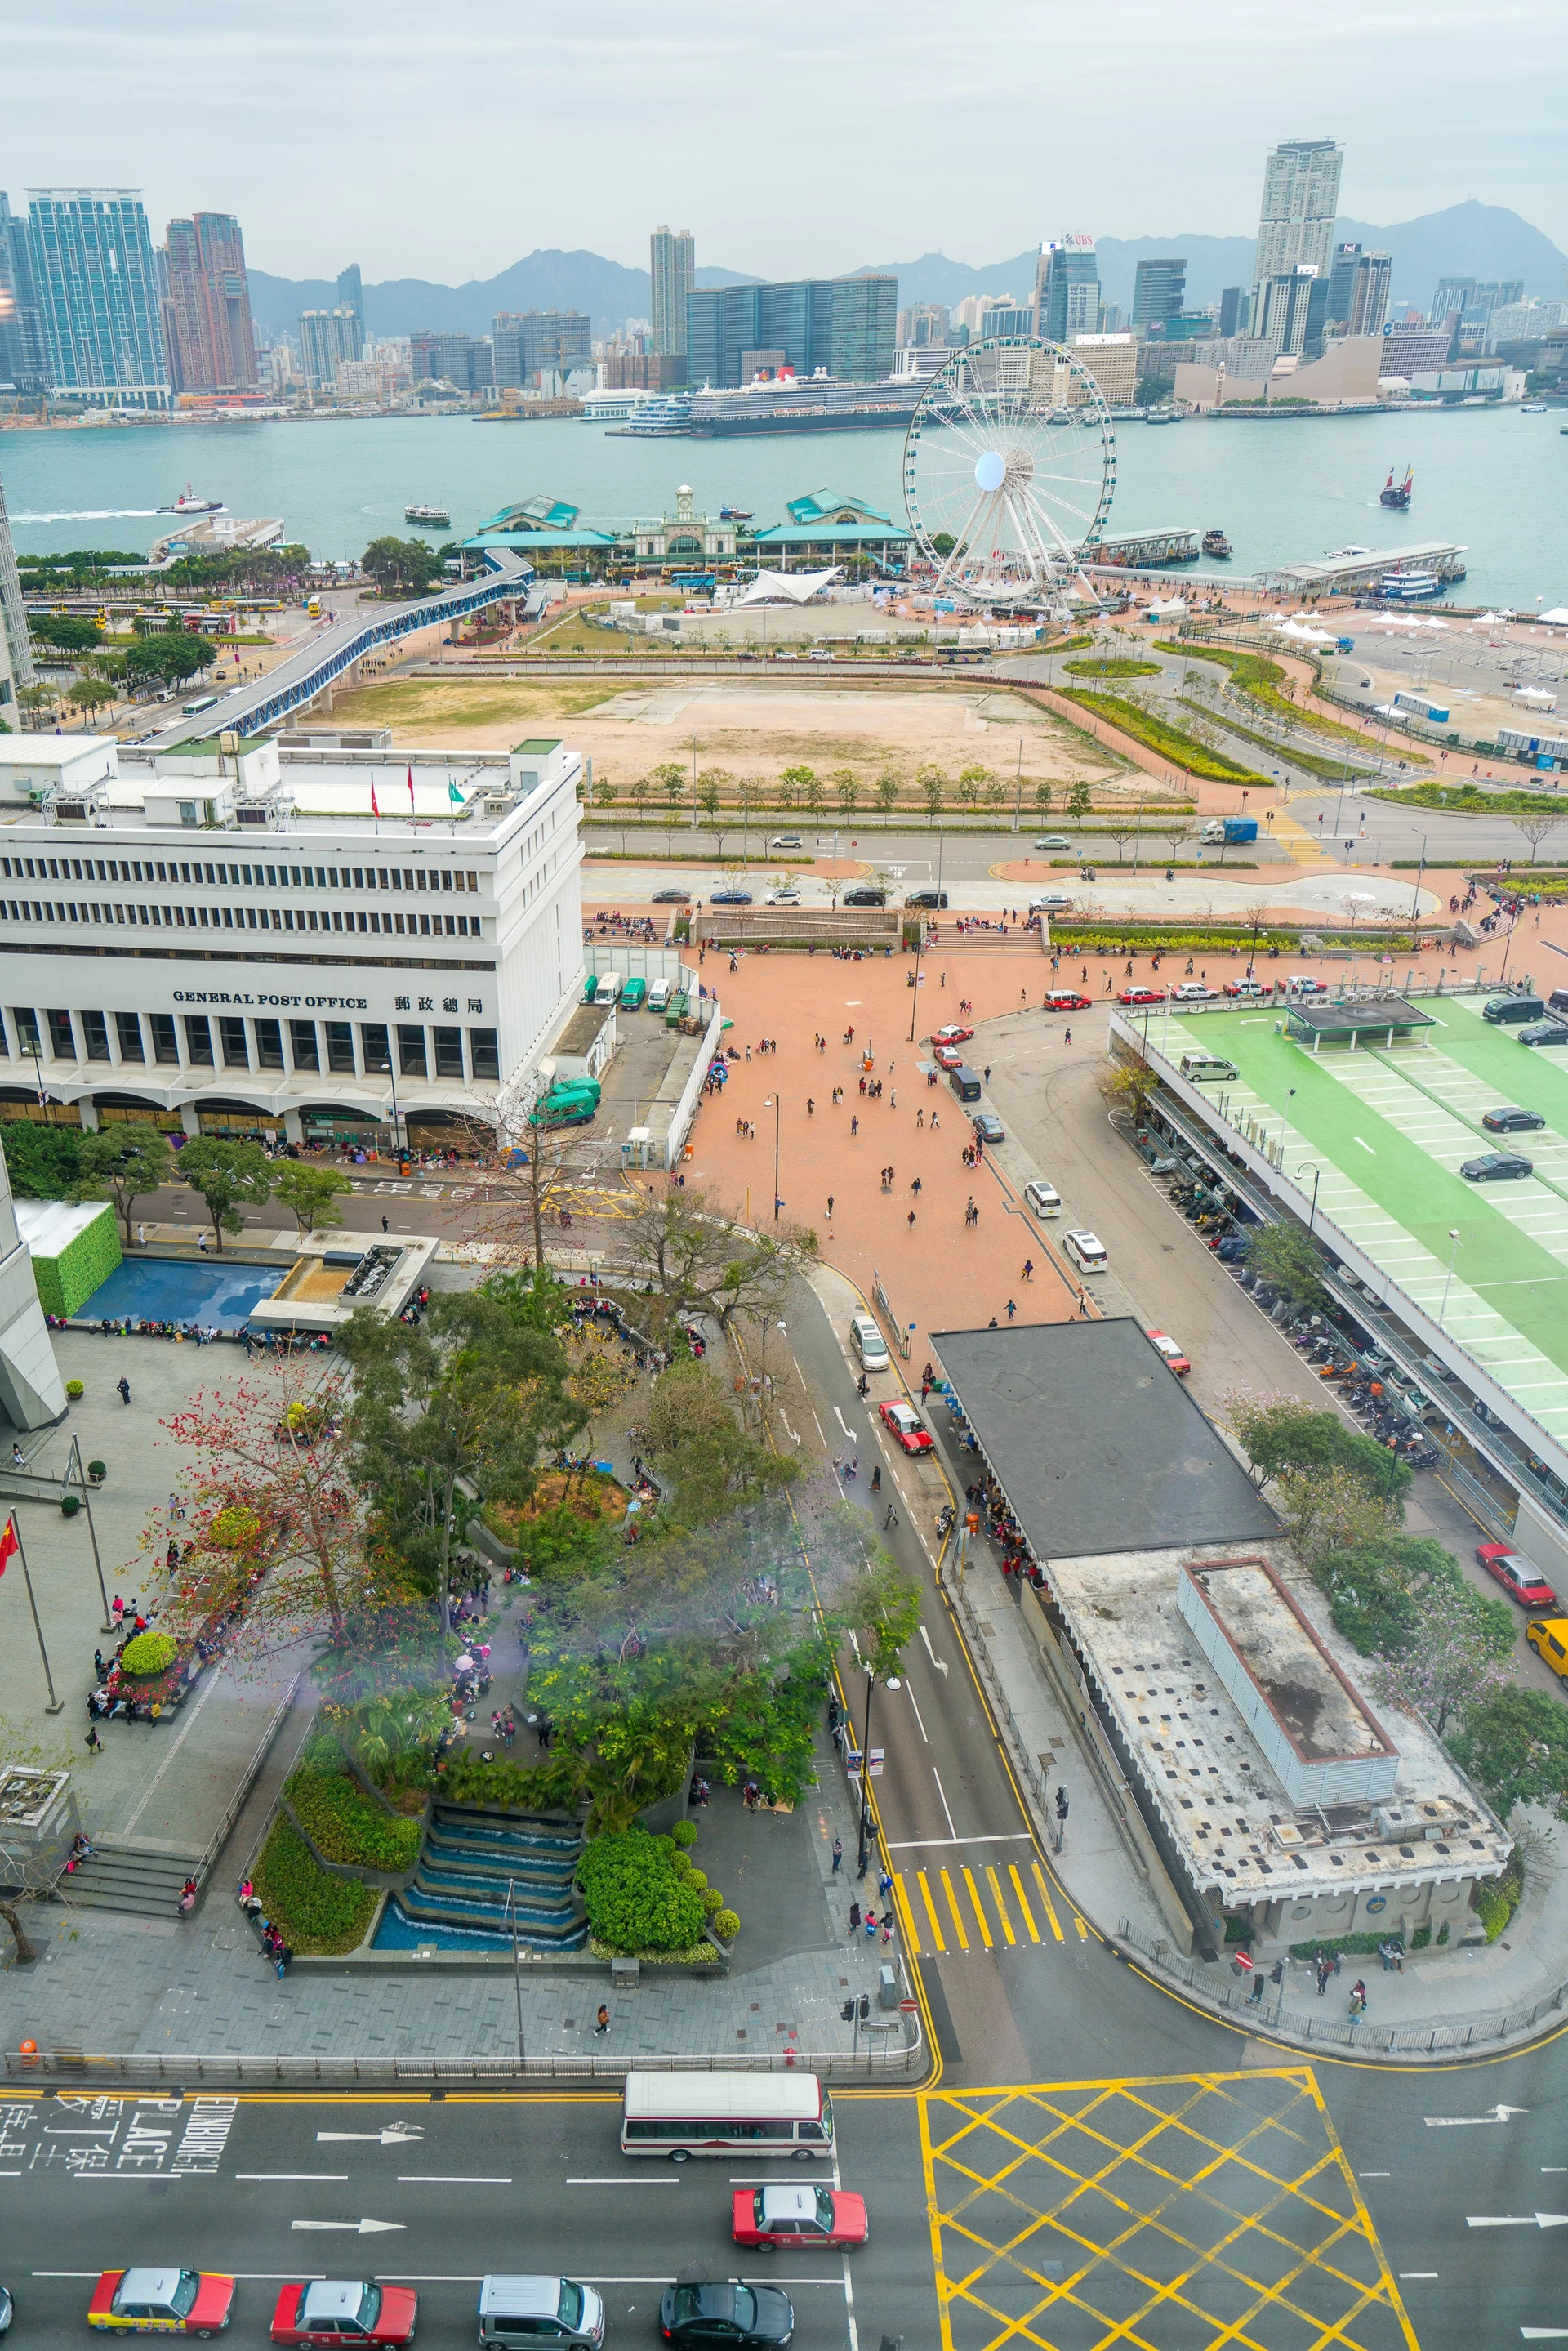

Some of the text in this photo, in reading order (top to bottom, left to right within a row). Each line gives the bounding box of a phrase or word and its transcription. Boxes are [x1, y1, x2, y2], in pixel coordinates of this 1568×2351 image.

[1075, 235, 1093, 245] UBS
[1343, 244, 1356, 252] PIAGET
[1068, 285, 1078, 328] 理財有道
[1078, 285, 1088, 328] 瑞銀集團
[1393, 322, 1441, 330] 中国建设银行
[173, 991, 367, 1009] GENERAL POST OFFICE
[394, 996, 483, 1013] 郵政總局
[418, 1184, 444, 1198] STOP
[116, 2099, 183, 2170] PLACE
[171, 2097, 239, 2173] EDINBURGH
